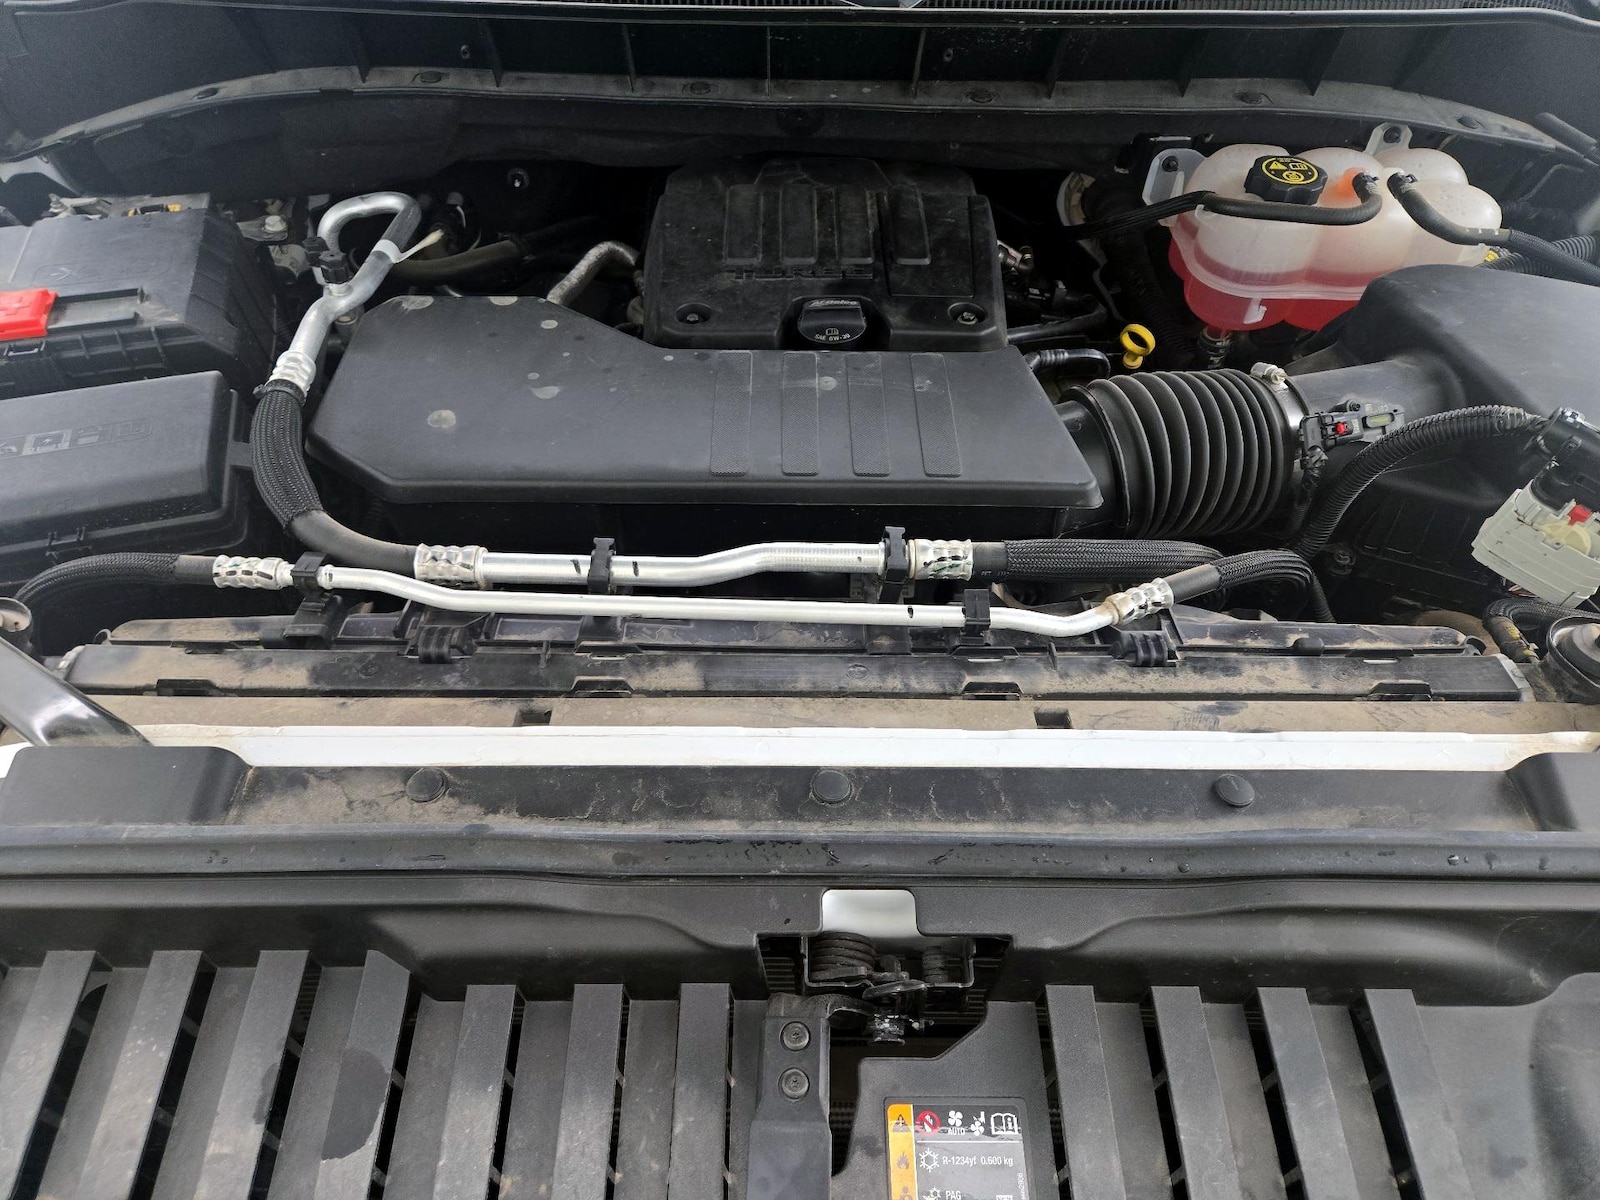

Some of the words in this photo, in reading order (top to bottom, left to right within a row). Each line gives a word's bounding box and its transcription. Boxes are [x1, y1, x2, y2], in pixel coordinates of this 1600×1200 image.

[947, 1127, 965, 1136] AUTO
[942, 1156, 977, 1167] R-1234yf
[980, 1156, 1002, 1166] 0.600
[1003, 1156, 1014, 1167] kg
[945, 1190, 961, 1200] PAG
